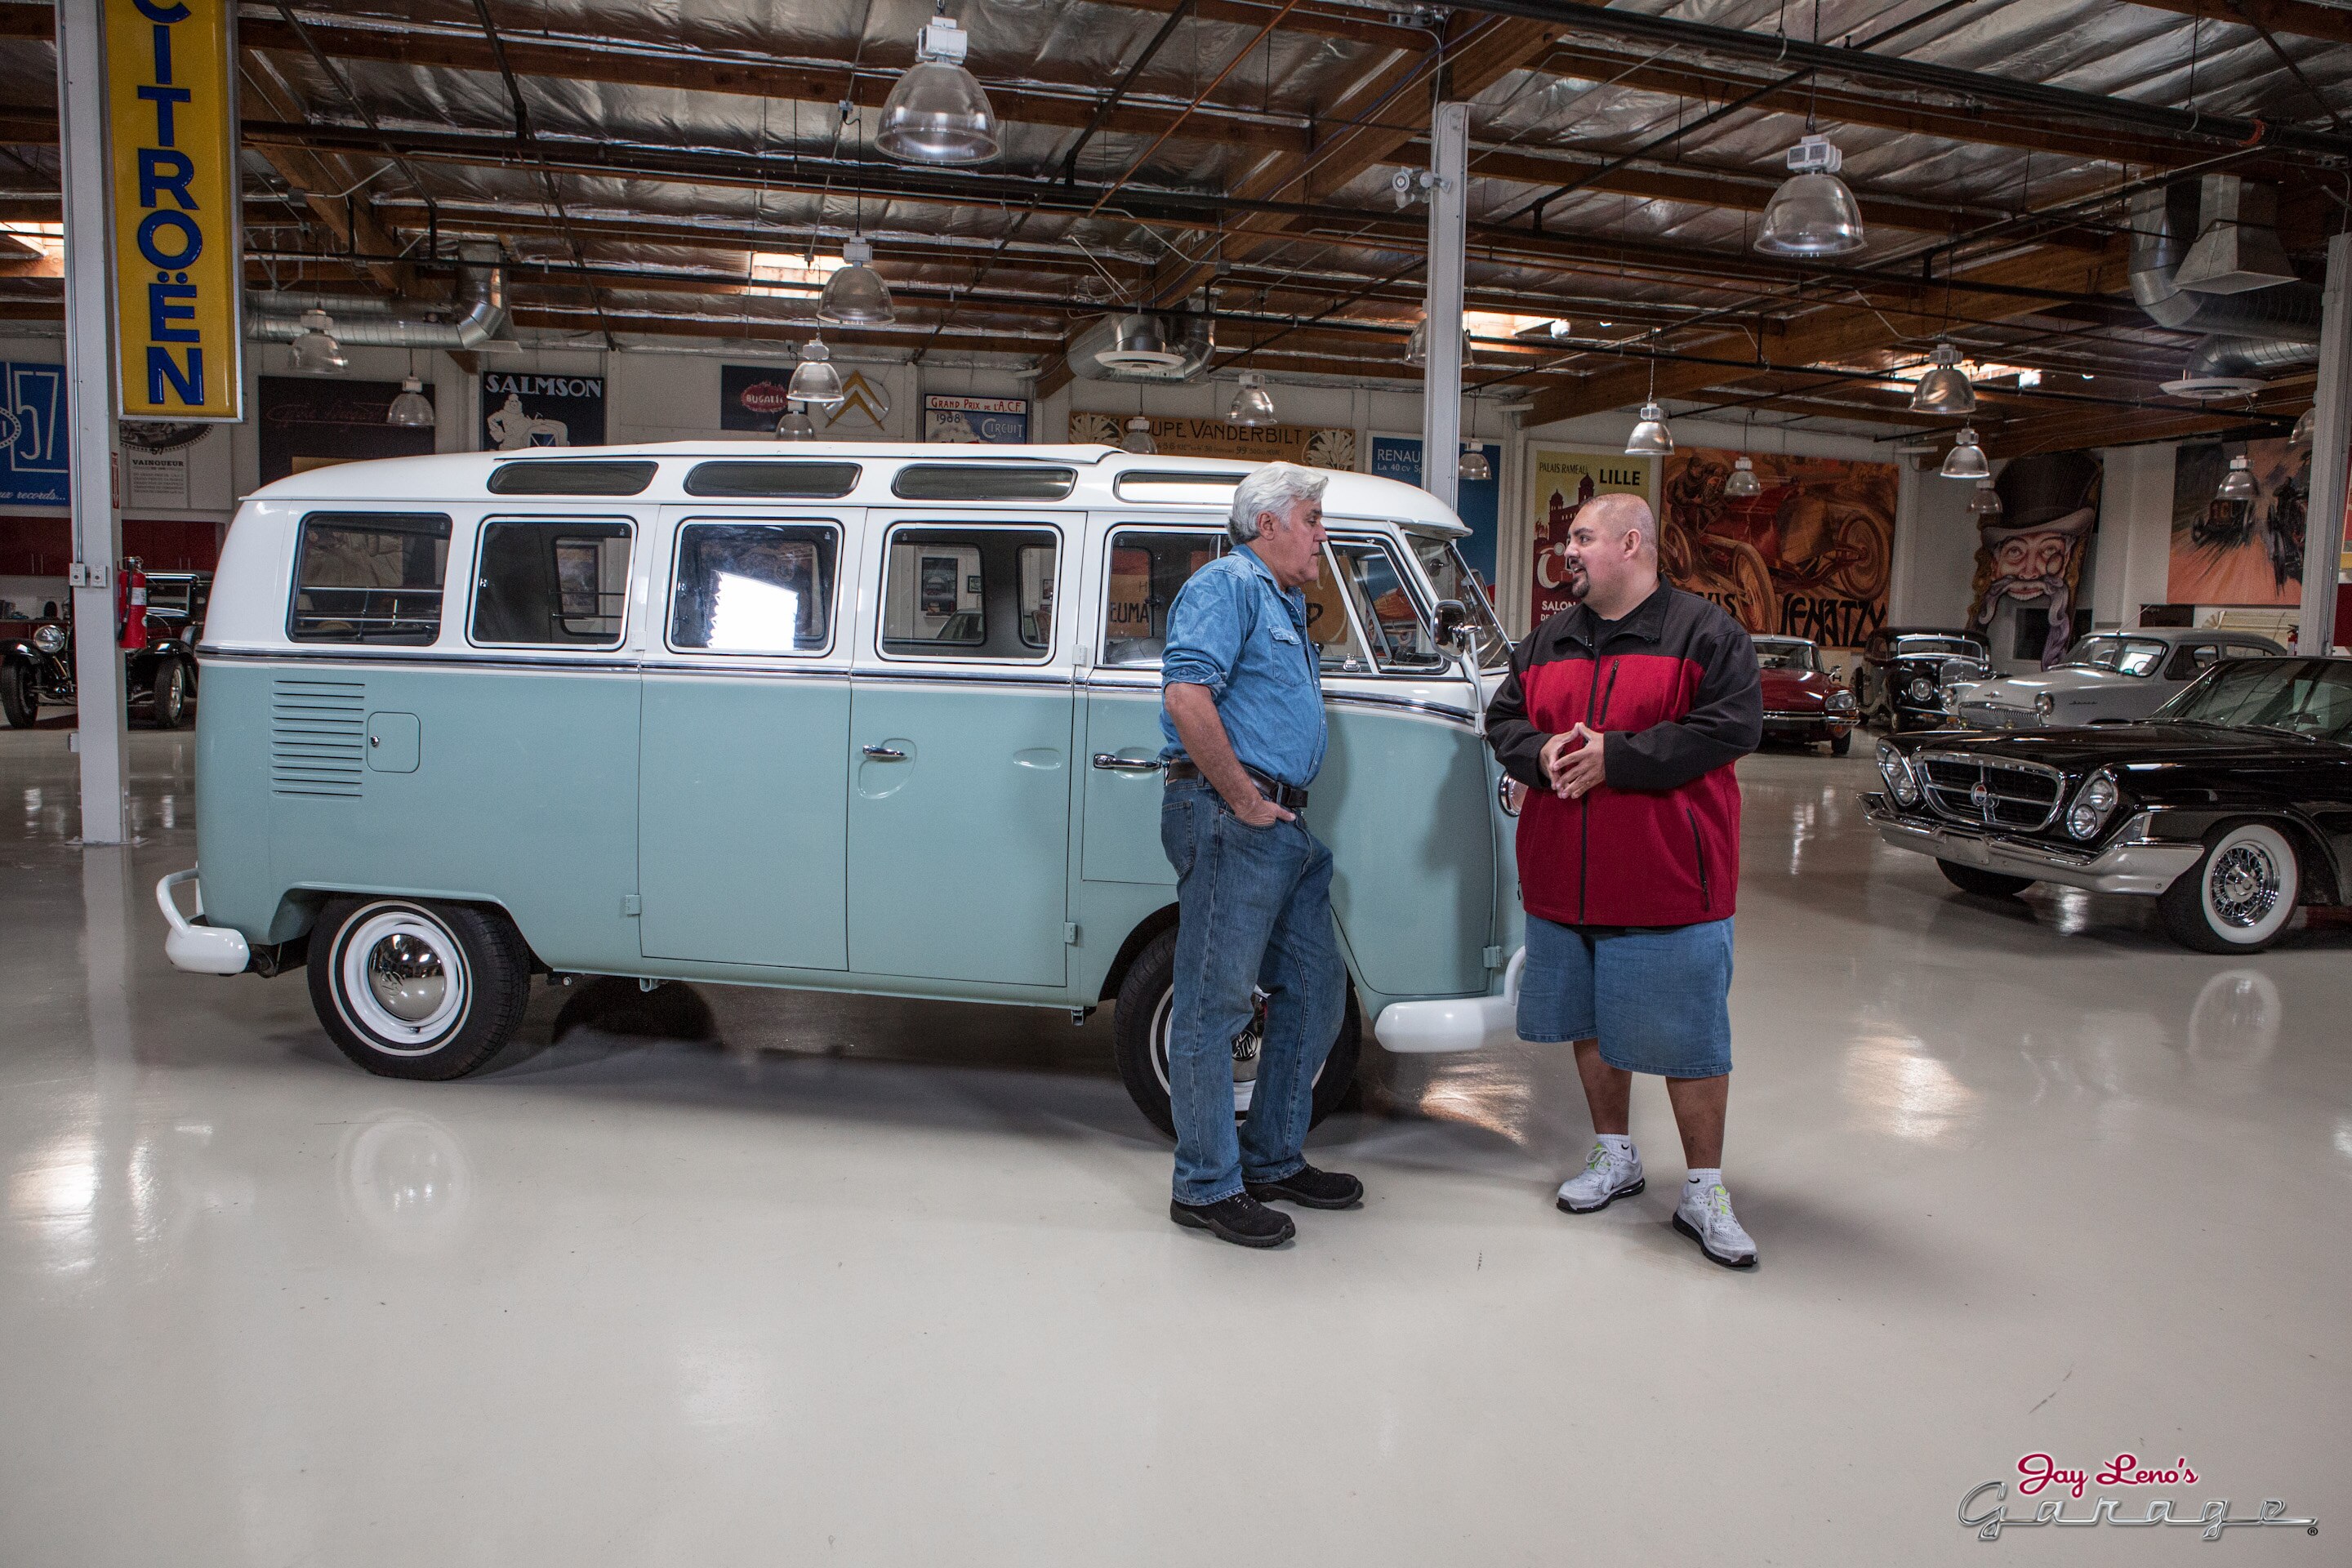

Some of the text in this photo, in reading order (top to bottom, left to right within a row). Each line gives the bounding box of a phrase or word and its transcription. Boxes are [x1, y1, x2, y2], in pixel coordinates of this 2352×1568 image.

[486, 374, 602, 398] SALMSON
[931, 397, 960, 410] GRAND
[964, 399, 981, 410] PRIX
[982, 418, 1023, 439] CIRCUIT
[1190, 420, 1303, 445] VANDERBILT
[1378, 449, 1421, 463] RENAU
[1539, 462, 1588, 475] PALAIS RAMEAU
[1599, 469, 1641, 486] LILLE
